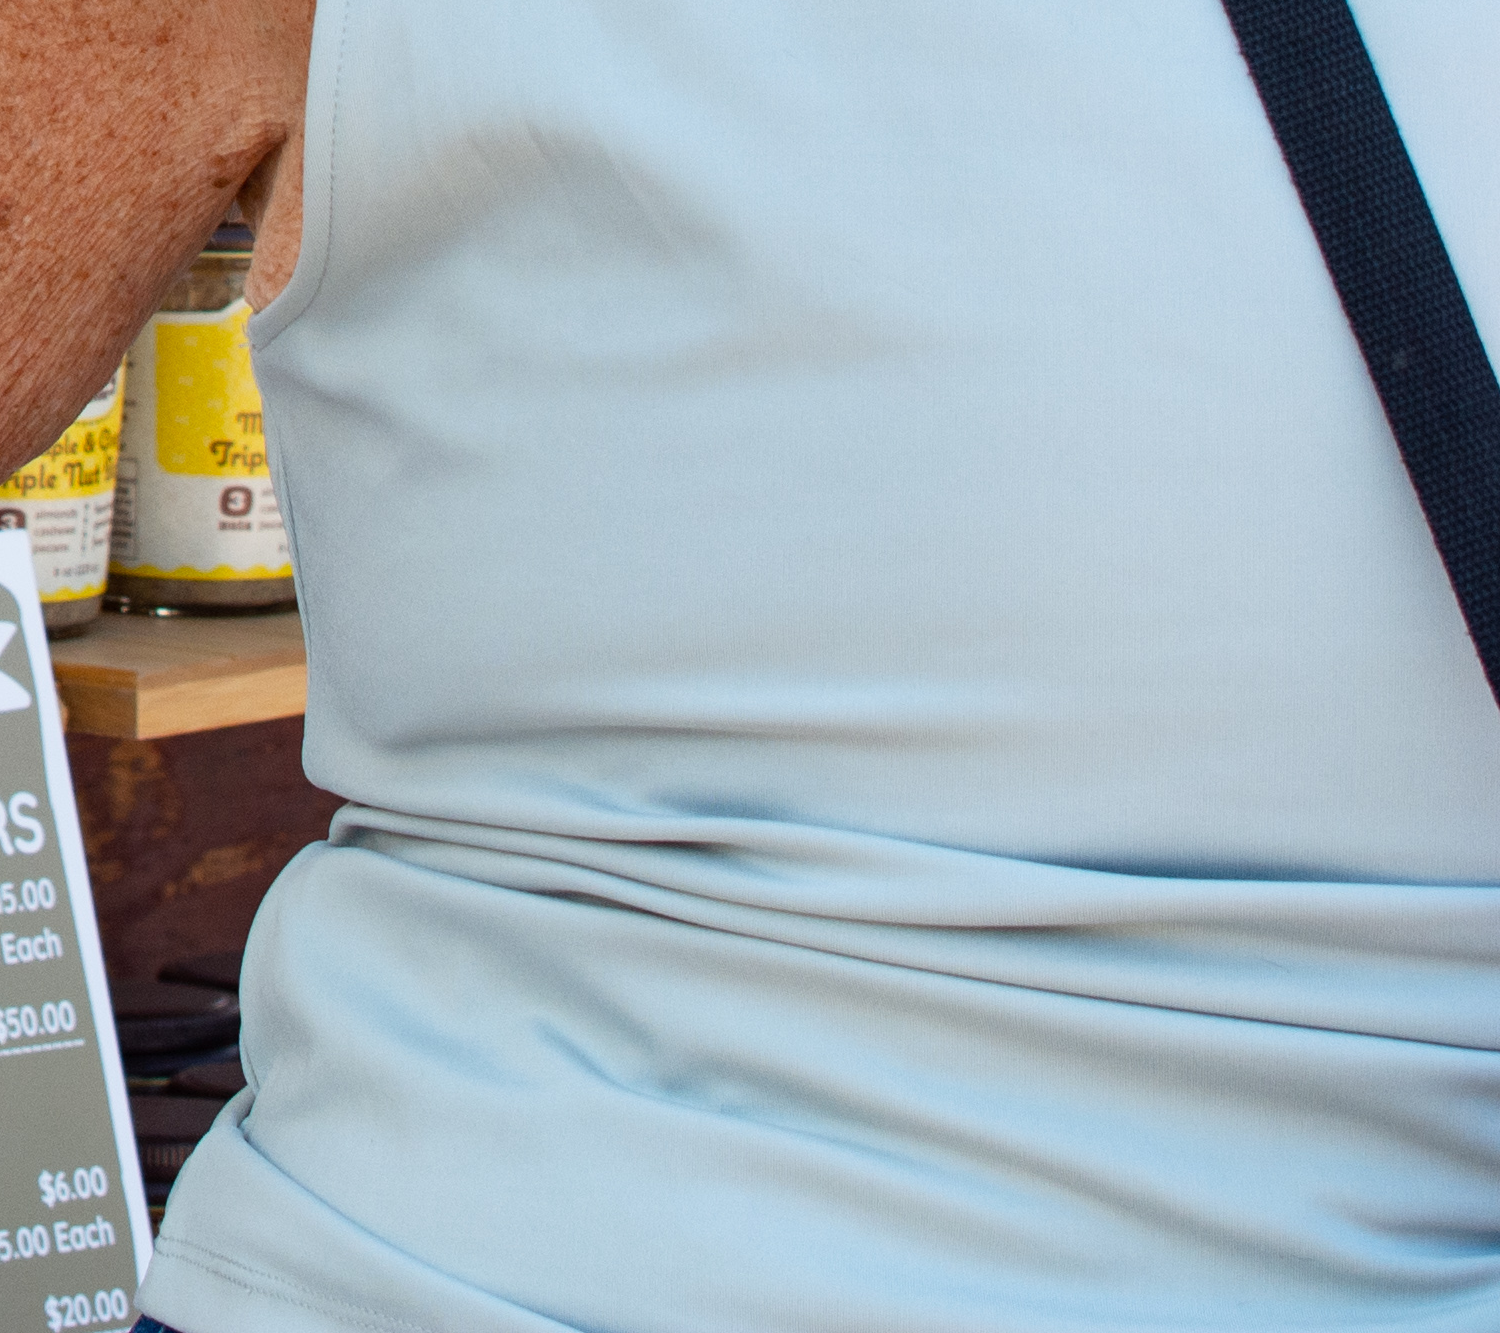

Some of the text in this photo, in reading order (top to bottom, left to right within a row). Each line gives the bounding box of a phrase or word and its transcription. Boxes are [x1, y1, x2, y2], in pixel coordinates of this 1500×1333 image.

[1, 928, 62, 964] Each
[39, 1166, 107, 1207] $6.00
[54, 1216, 115, 1253] Each
[44, 1288, 129, 1332] $20.00
